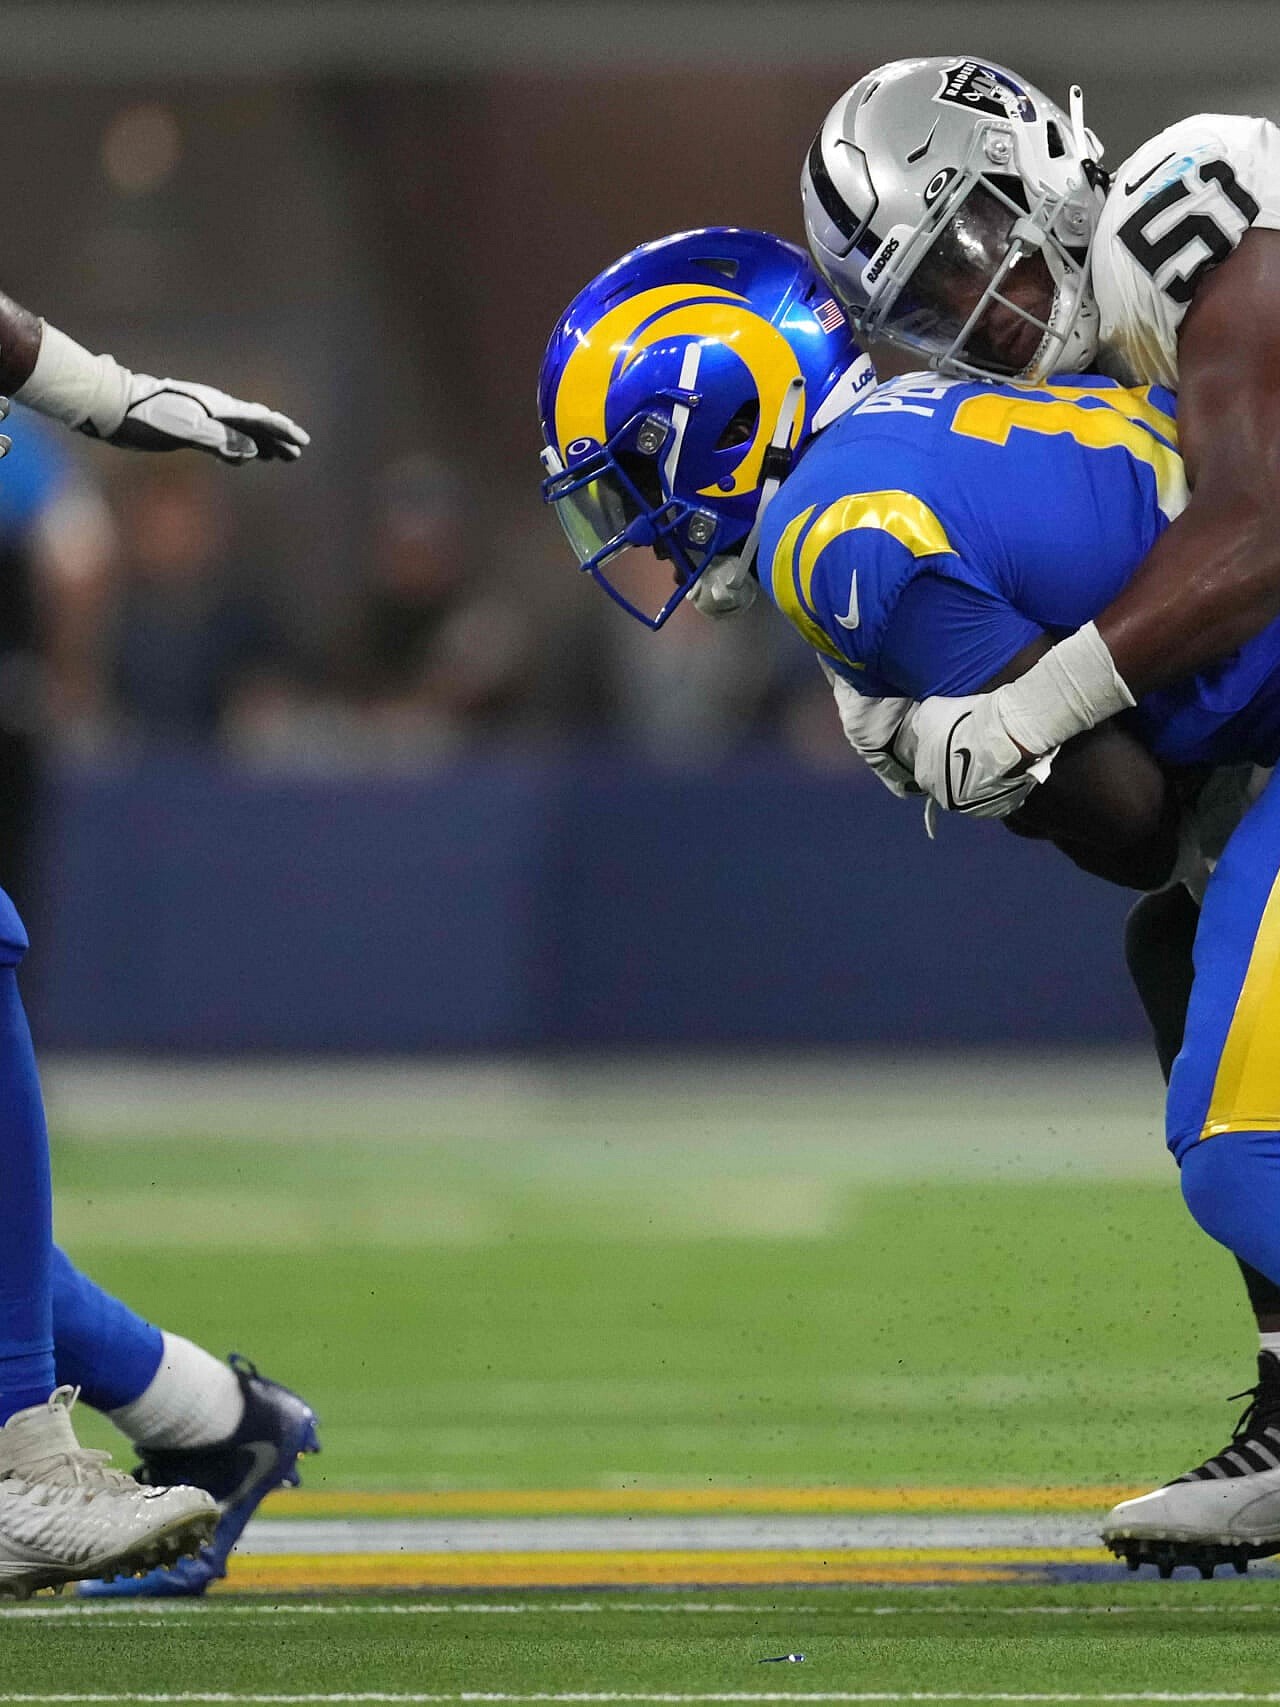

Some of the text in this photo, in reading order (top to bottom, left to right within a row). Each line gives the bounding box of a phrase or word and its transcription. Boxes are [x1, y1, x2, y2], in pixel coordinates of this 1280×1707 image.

[945, 63, 978, 97] RAIDERS
[1116, 159, 1260, 303] 51
[866, 237, 899, 283] RAIDERS
